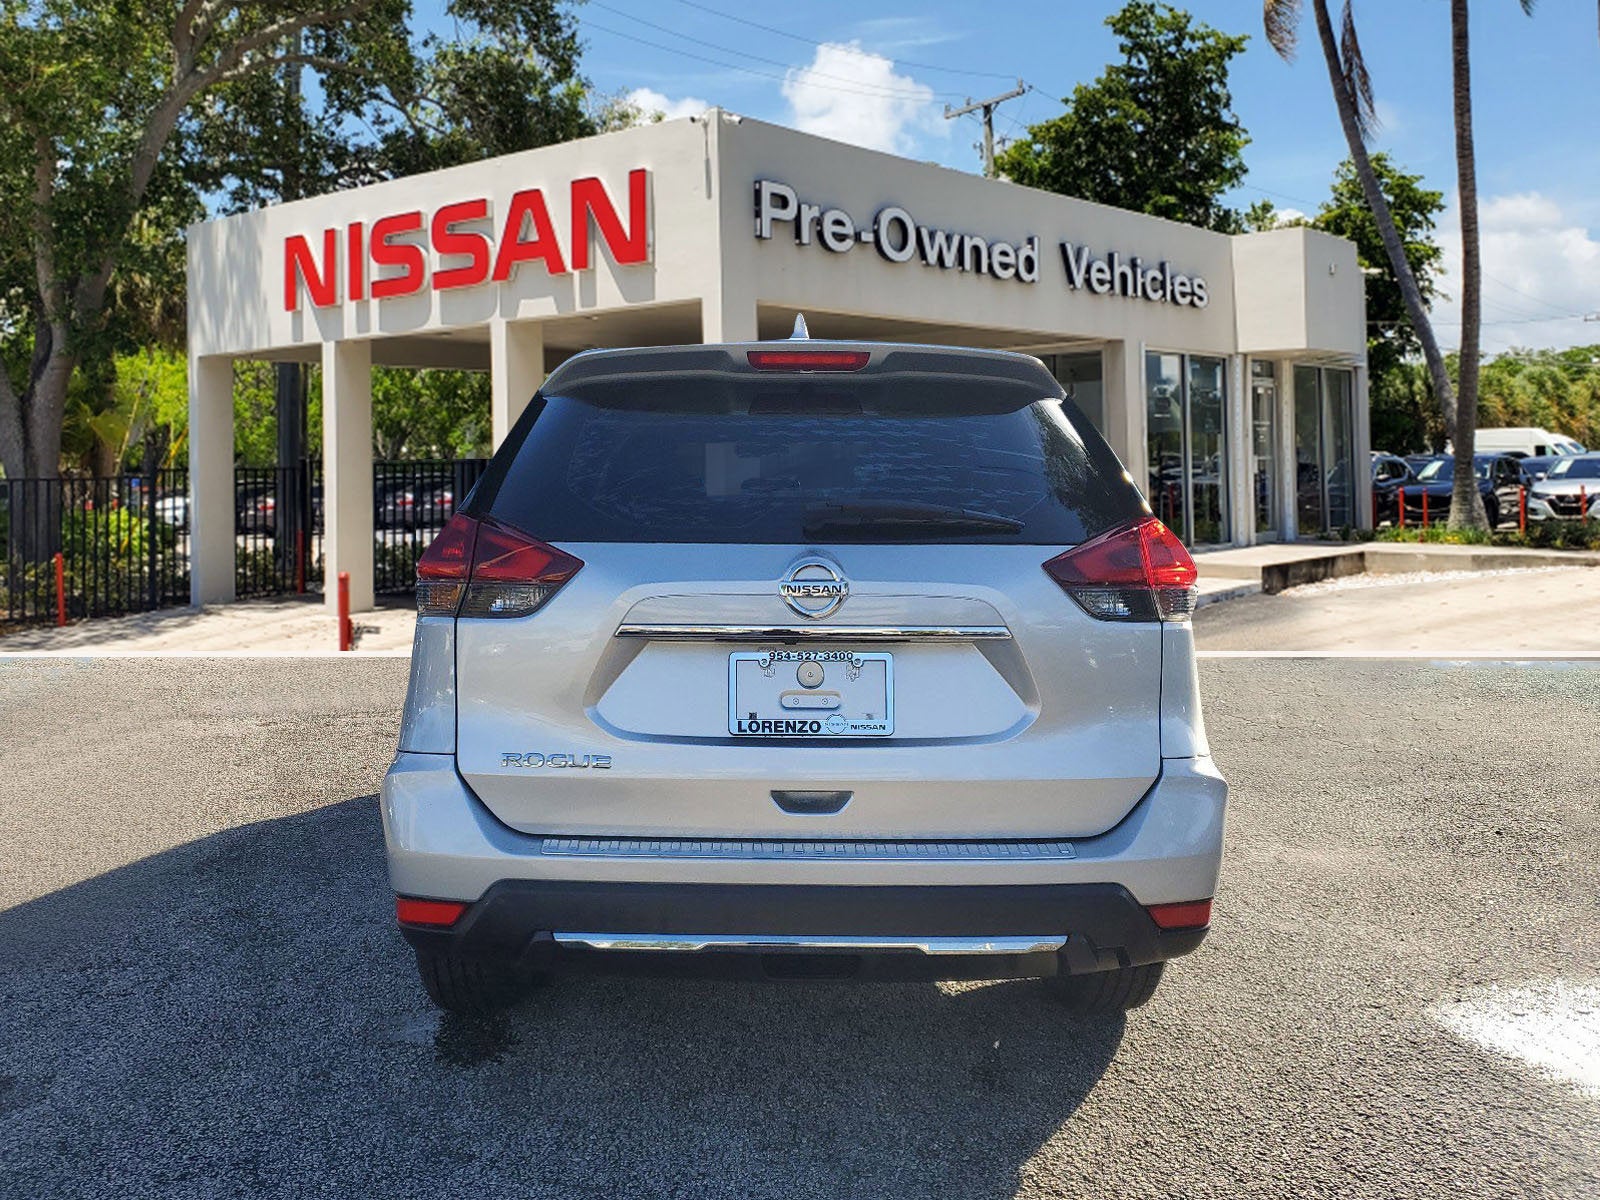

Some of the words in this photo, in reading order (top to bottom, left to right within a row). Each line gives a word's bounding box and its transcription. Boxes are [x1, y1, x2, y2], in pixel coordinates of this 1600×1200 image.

[284, 168, 647, 312] NISSAN
[754, 179, 1040, 284] Pre-Owned
[1059, 241, 1209, 309] Vehicles
[786, 584, 842, 594] NISSAN
[769, 652, 854, 661] 954-527-3400
[737, 720, 822, 733] LORENZO
[501, 752, 612, 769] ROGUE
